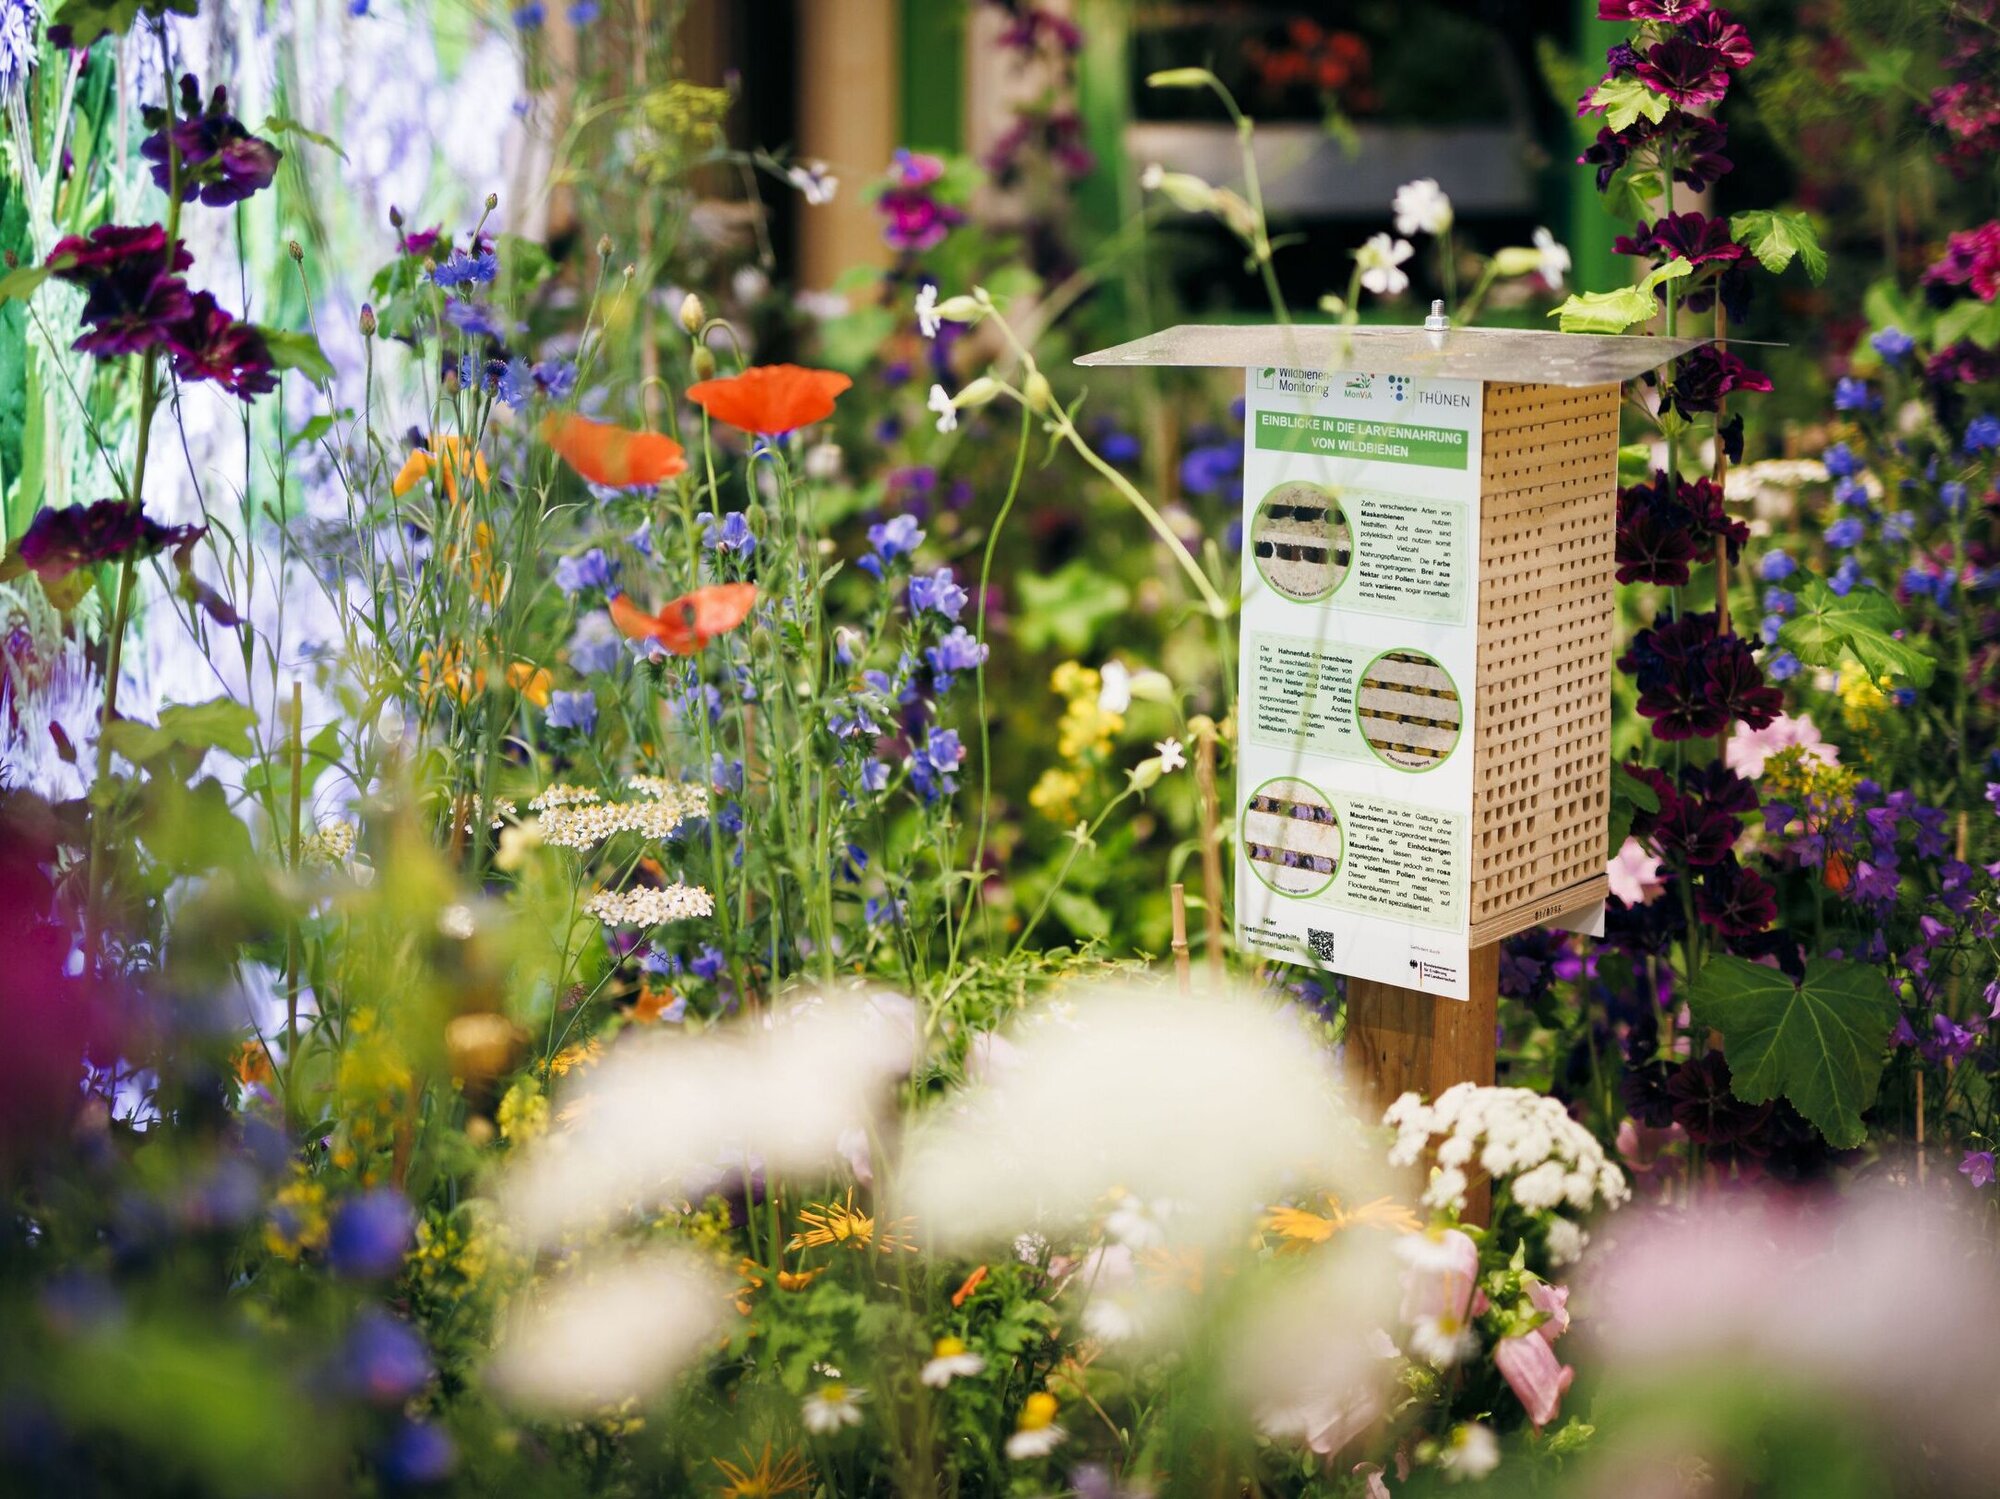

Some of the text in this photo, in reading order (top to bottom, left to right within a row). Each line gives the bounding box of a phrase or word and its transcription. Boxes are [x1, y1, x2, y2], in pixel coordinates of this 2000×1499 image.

[1279, 379, 1329, 397] Monitoring
[1344, 390, 1373, 399] MonViA
[1419, 390, 1470, 407] THÜNEN
[1262, 415, 1462, 444] EINBLICKE IN DIE LARVENNAHRUNG
[1312, 437, 1408, 457] VON WILDBIENEN
[1350, 812, 1388, 824] Mauerbienen
[1349, 841, 1384, 853] Mauerbiene
[1248, 937, 1294, 952] herunterladen
